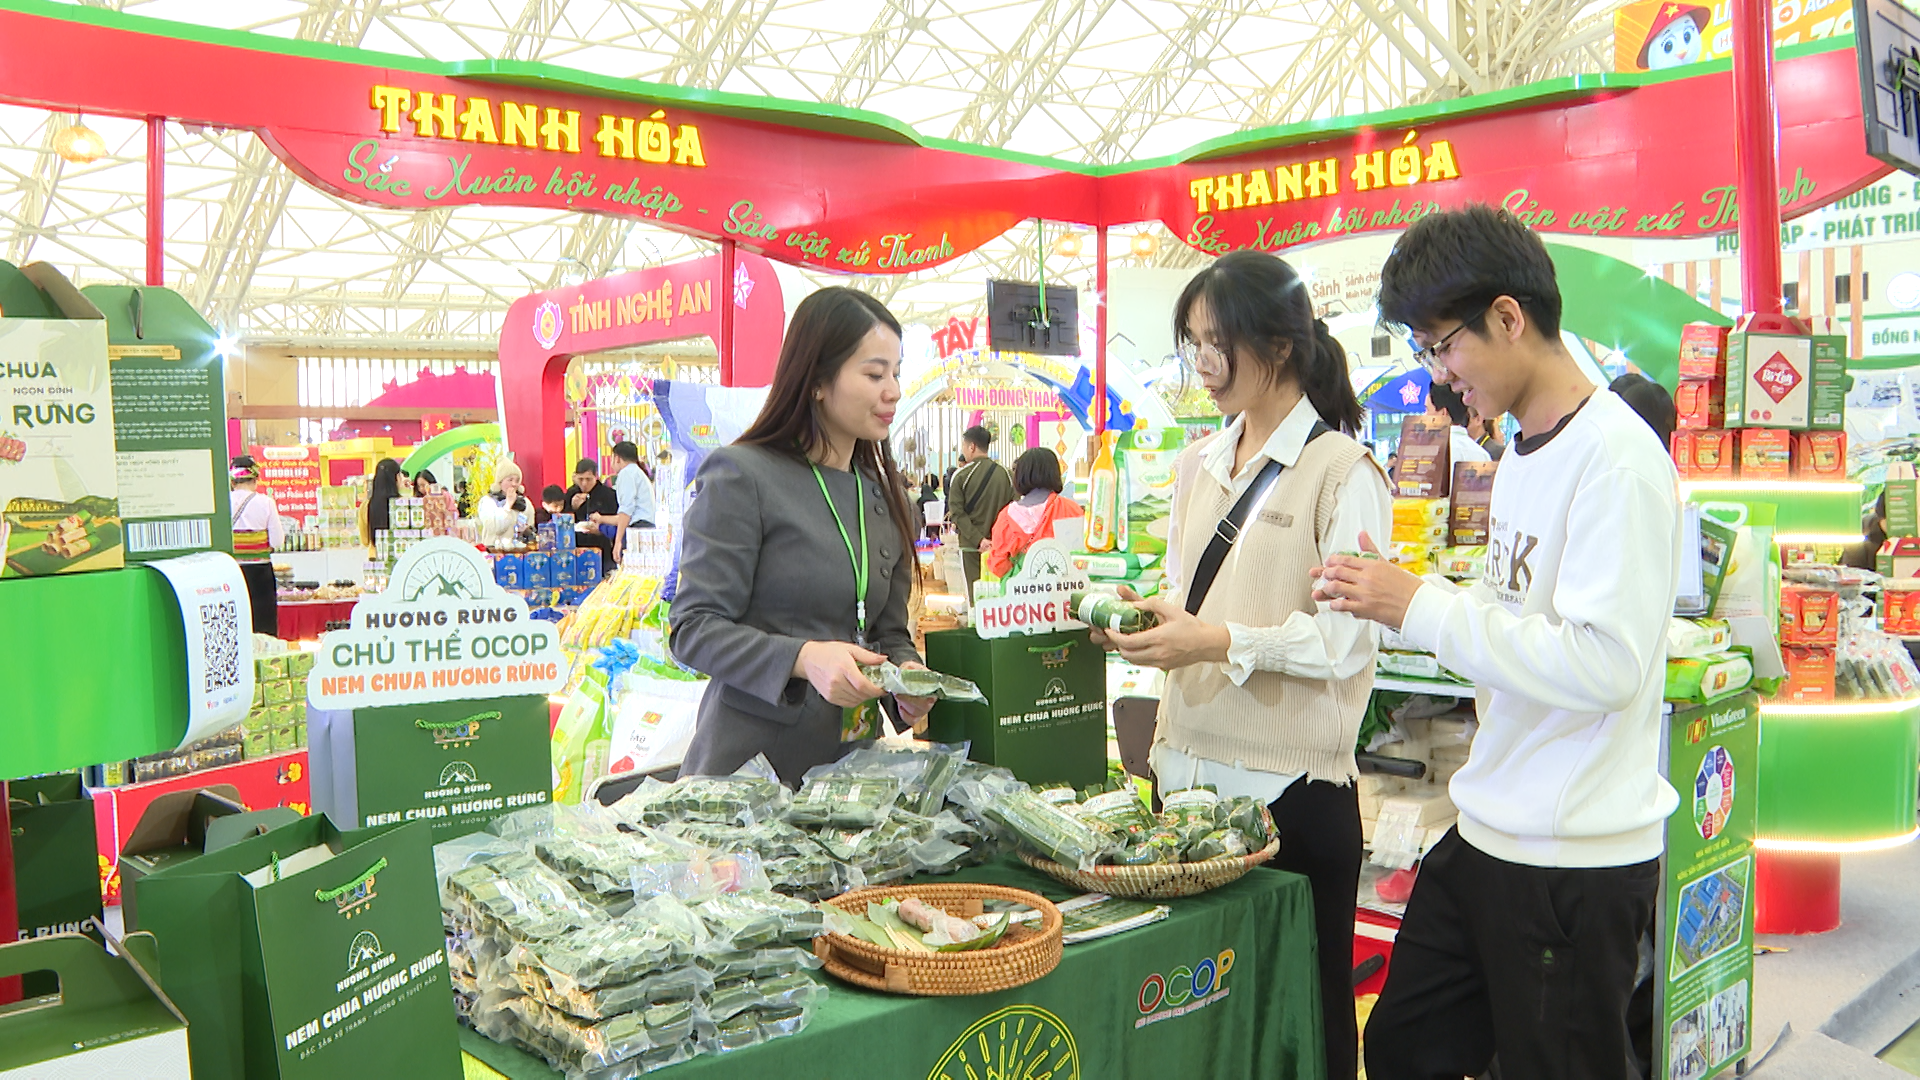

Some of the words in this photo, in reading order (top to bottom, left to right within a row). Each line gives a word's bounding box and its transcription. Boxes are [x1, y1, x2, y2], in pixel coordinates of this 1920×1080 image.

[372, 85, 582, 153] THANH
[594, 109, 706, 167] HÓA
[1190, 157, 1339, 213] THANH
[1351, 129, 1461, 192] HÓA
[344, 140, 412, 197] Sắc
[425, 153, 538, 201] Xuân
[545, 167, 598, 205] hội
[603, 178, 684, 218] nhập
[723, 200, 779, 241] Sản
[785, 231, 830, 261] vật
[836, 241, 870, 267] xứ
[878, 231, 954, 269] Thanh
[1187, 214, 1231, 256] Sắc
[1238, 216, 1321, 251] Xuân
[1327, 206, 1368, 236] hội
[1568, 206, 1627, 237] vật
[1635, 201, 1685, 232] xứ
[1698, 167, 1817, 230] Thnh
[1824, 213, 1876, 242] PHÁT
[1312, 279, 1340, 299] Sảnh
[1345, 273, 1365, 287] Sảnh
[569, 295, 611, 334] TỈNH
[616, 279, 673, 327] NGHỆ
[678, 279, 712, 316] AN
[931, 316, 979, 359] TÂY
[366, 611, 448, 628] HƯƠNG
[458, 606, 518, 625] RỪNG
[982, 601, 1057, 630] HƯƠNG
[332, 635, 395, 667] CHỦ
[405, 628, 462, 662] THỂ
[471, 633, 549, 659] OCOP
[321, 675, 365, 696] NEM
[371, 671, 427, 692] CHUA
[432, 665, 502, 687] HƯƠNG
[507, 660, 558, 682] RỪNG
[432, 721, 480, 739] OOP
[1000, 715, 1021, 726] NEM
[1024, 711, 1050, 723] CHUA
[1711, 707, 1747, 729] VinaGreen
[366, 812, 400, 828] NEM
[405, 805, 448, 821] CHUA
[334, 874, 376, 908] OOP
[1137, 948, 1236, 1014] OCOP
[285, 1018, 320, 1051] NEM
[322, 995, 362, 1031] CHUA
[362, 968, 408, 1006] HƯƠNG
